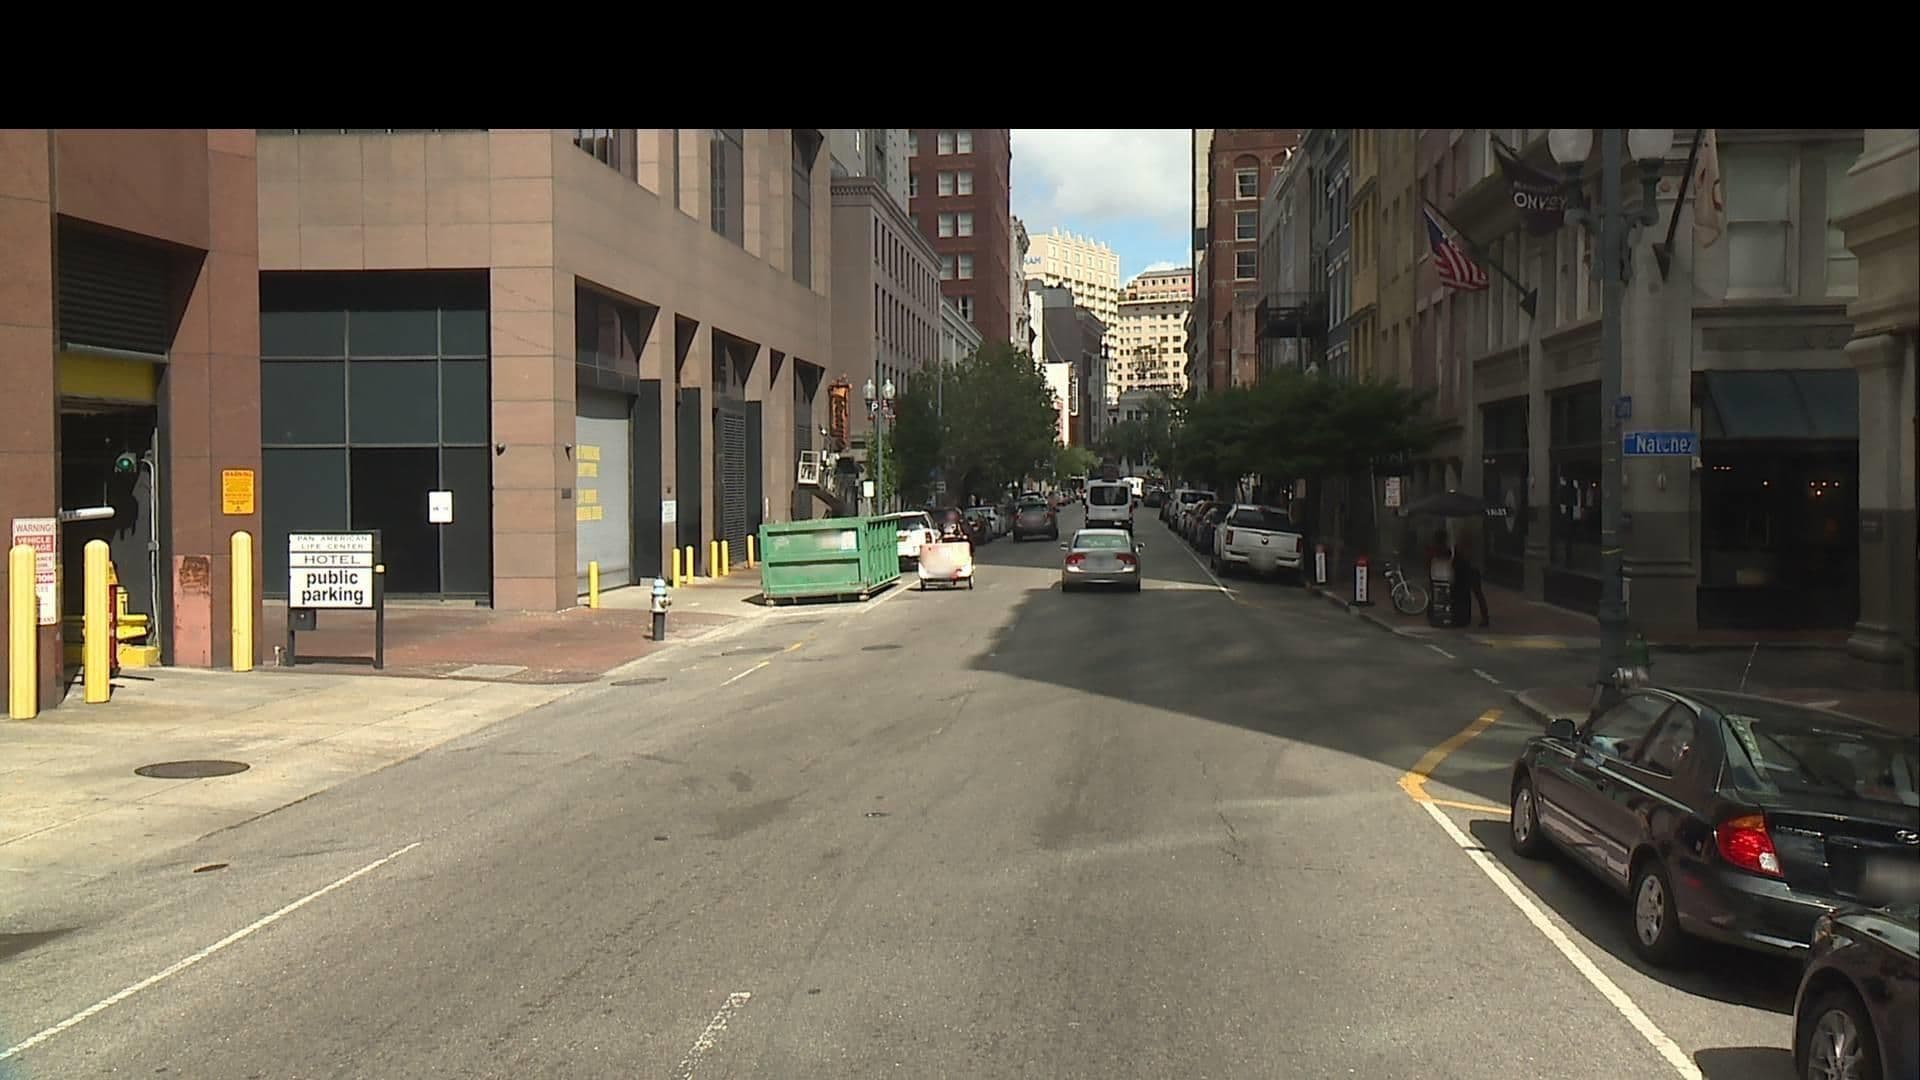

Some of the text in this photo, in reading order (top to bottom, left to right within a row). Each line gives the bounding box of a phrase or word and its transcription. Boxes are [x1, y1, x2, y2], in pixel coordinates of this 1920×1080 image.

[304, 555, 361, 565] HOTEL
[306, 569, 359, 588] public
[301, 586, 364, 605] parking
